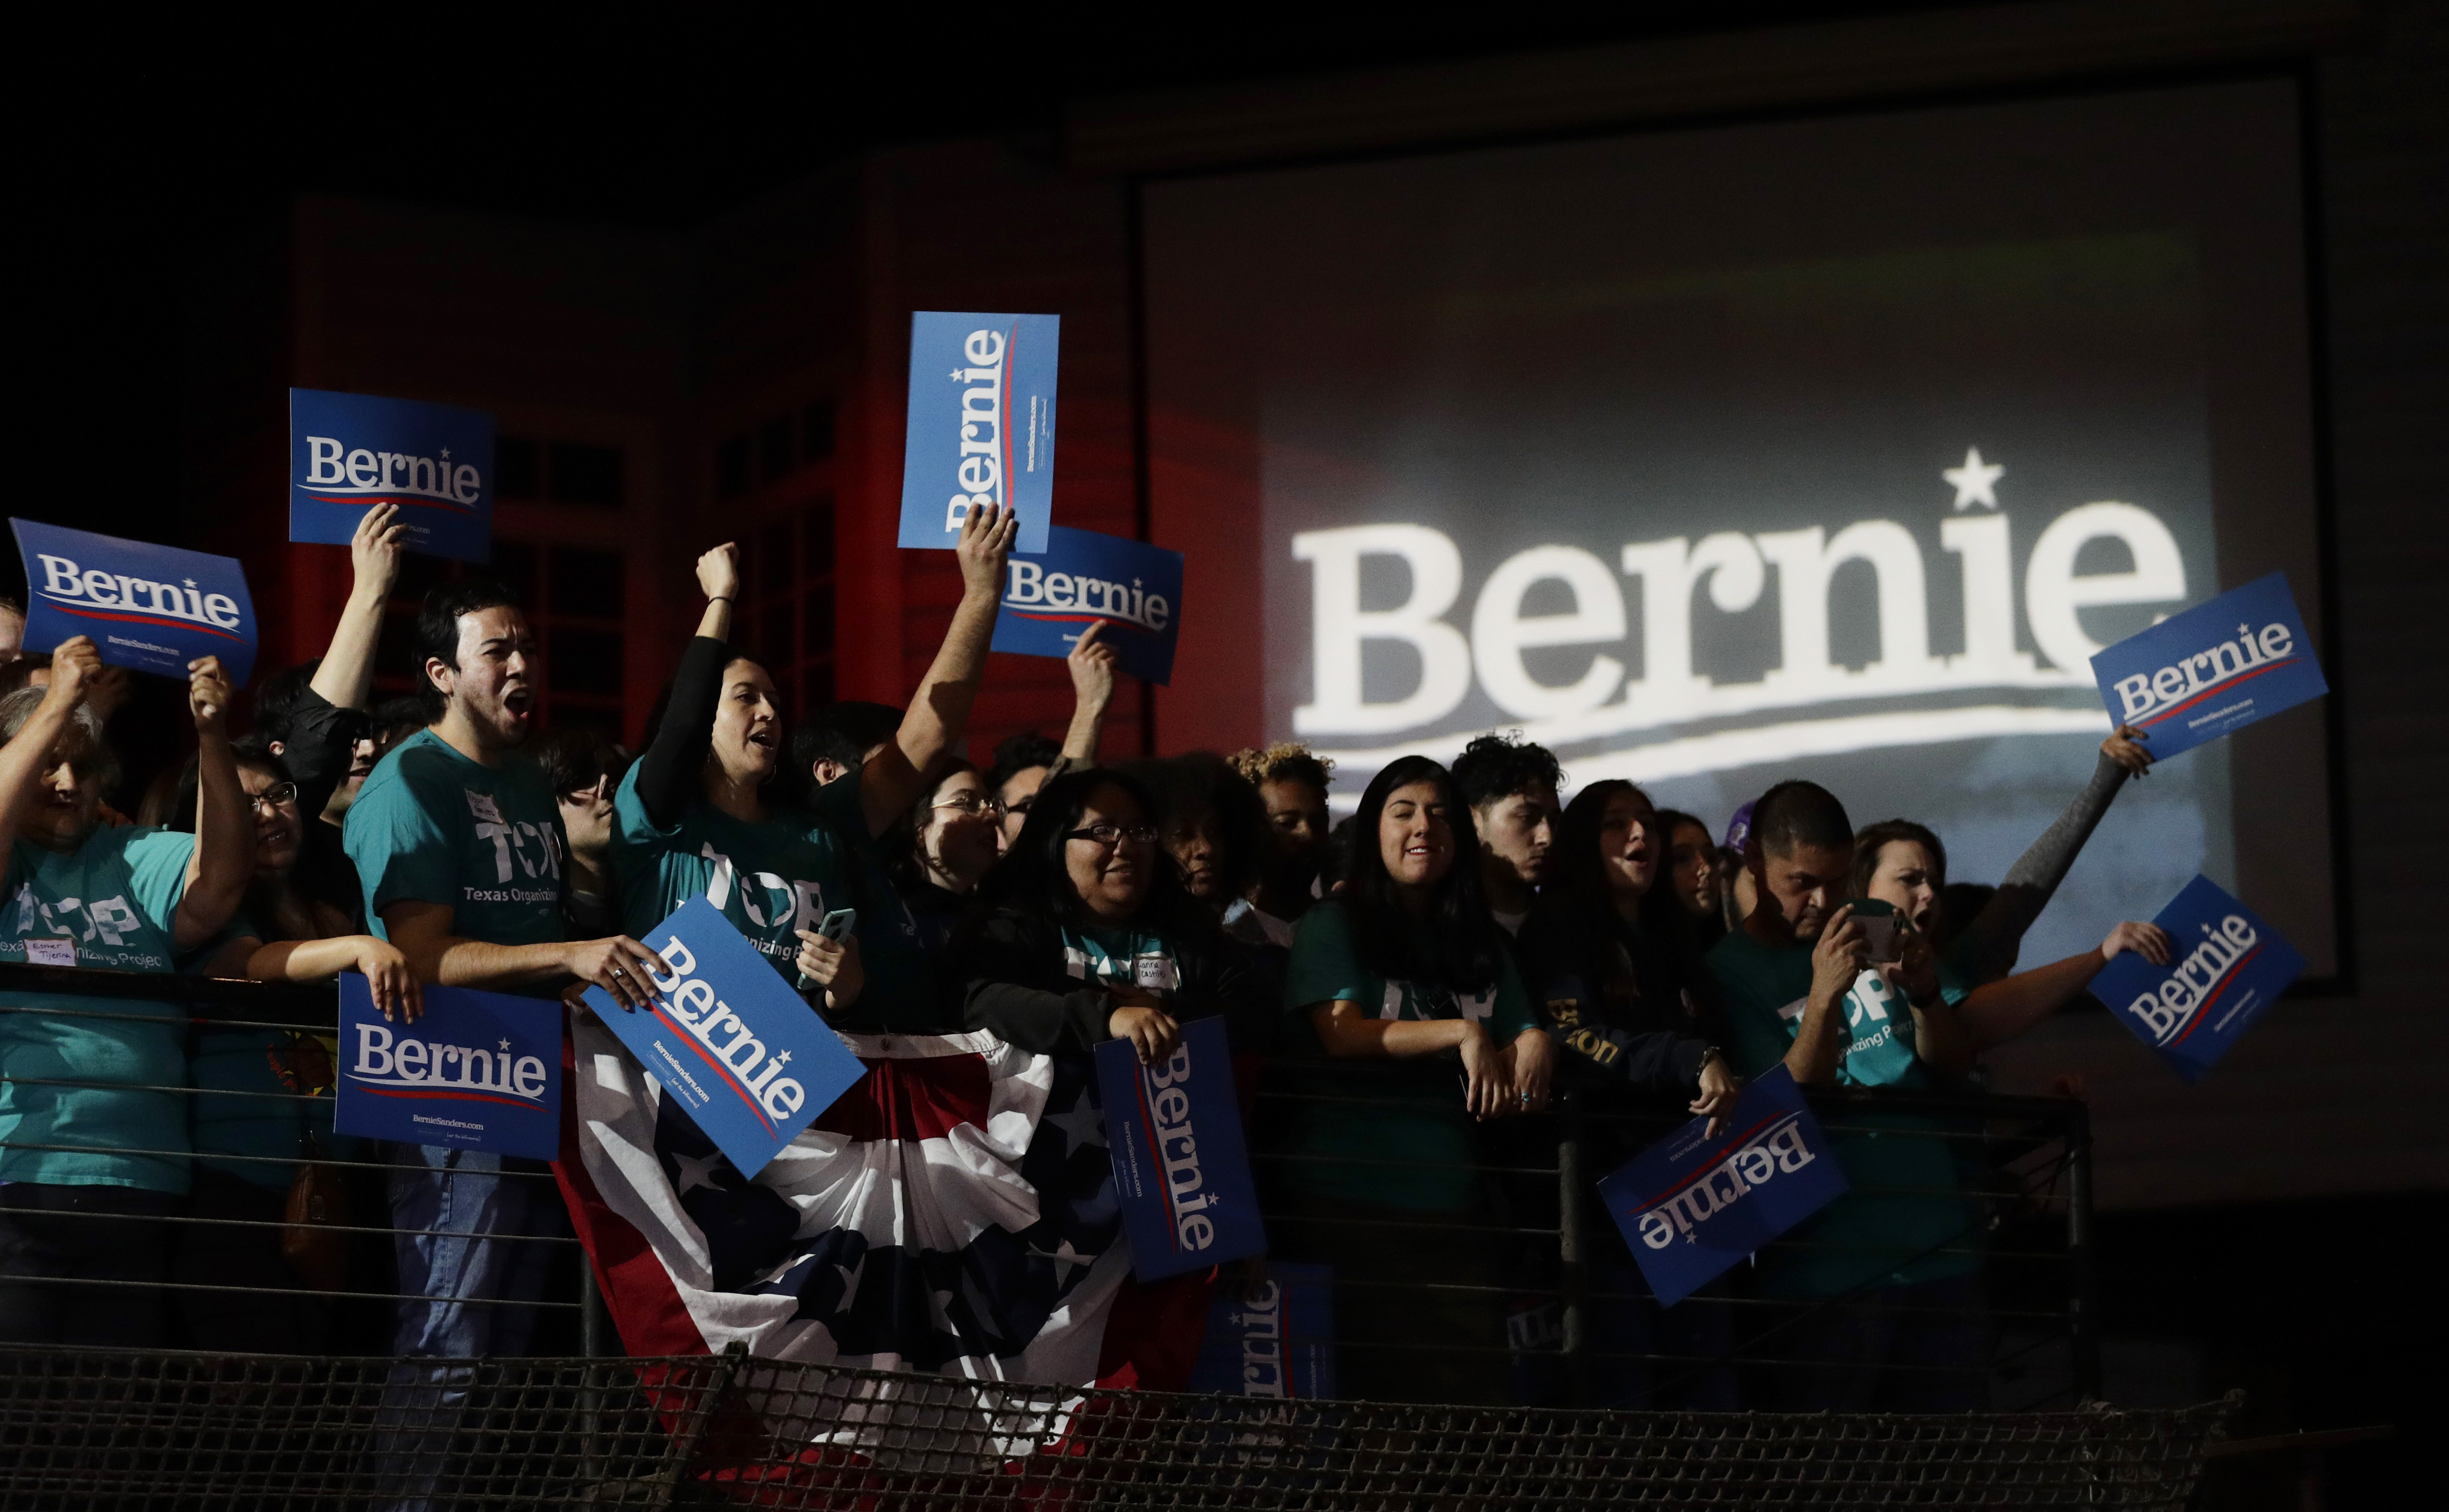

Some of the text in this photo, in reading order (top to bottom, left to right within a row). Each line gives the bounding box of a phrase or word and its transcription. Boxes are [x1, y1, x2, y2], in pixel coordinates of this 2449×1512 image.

[945, 329, 1005, 533] Bernie
[307, 436, 481, 505] Bernie
[37, 554, 241, 629] Bernie
[1006, 559, 1169, 631] Bernie
[1292, 445, 2187, 734] Bernie
[2114, 622, 2293, 720] Bernie
[13, 882, 141, 946] TOP
[464, 887, 508, 902] Texas
[702, 841, 824, 934] TOP
[0, 940, 162, 969] exa nizing Projec
[742, 935, 792, 960] nizing
[2128, 914, 2256, 1040] Bernie
[354, 1023, 546, 1097] Bernie
[640, 935, 805, 1120] Bernie
[653, 1040, 710, 1103] BernieSanders.com
[413, 1114, 484, 1130] BernieSanders.com
[1124, 1120, 1142, 1197] BernieSanders.com
[1151, 1041, 1220, 1252] Bernie
[1639, 1120, 1815, 1249] Bernie
